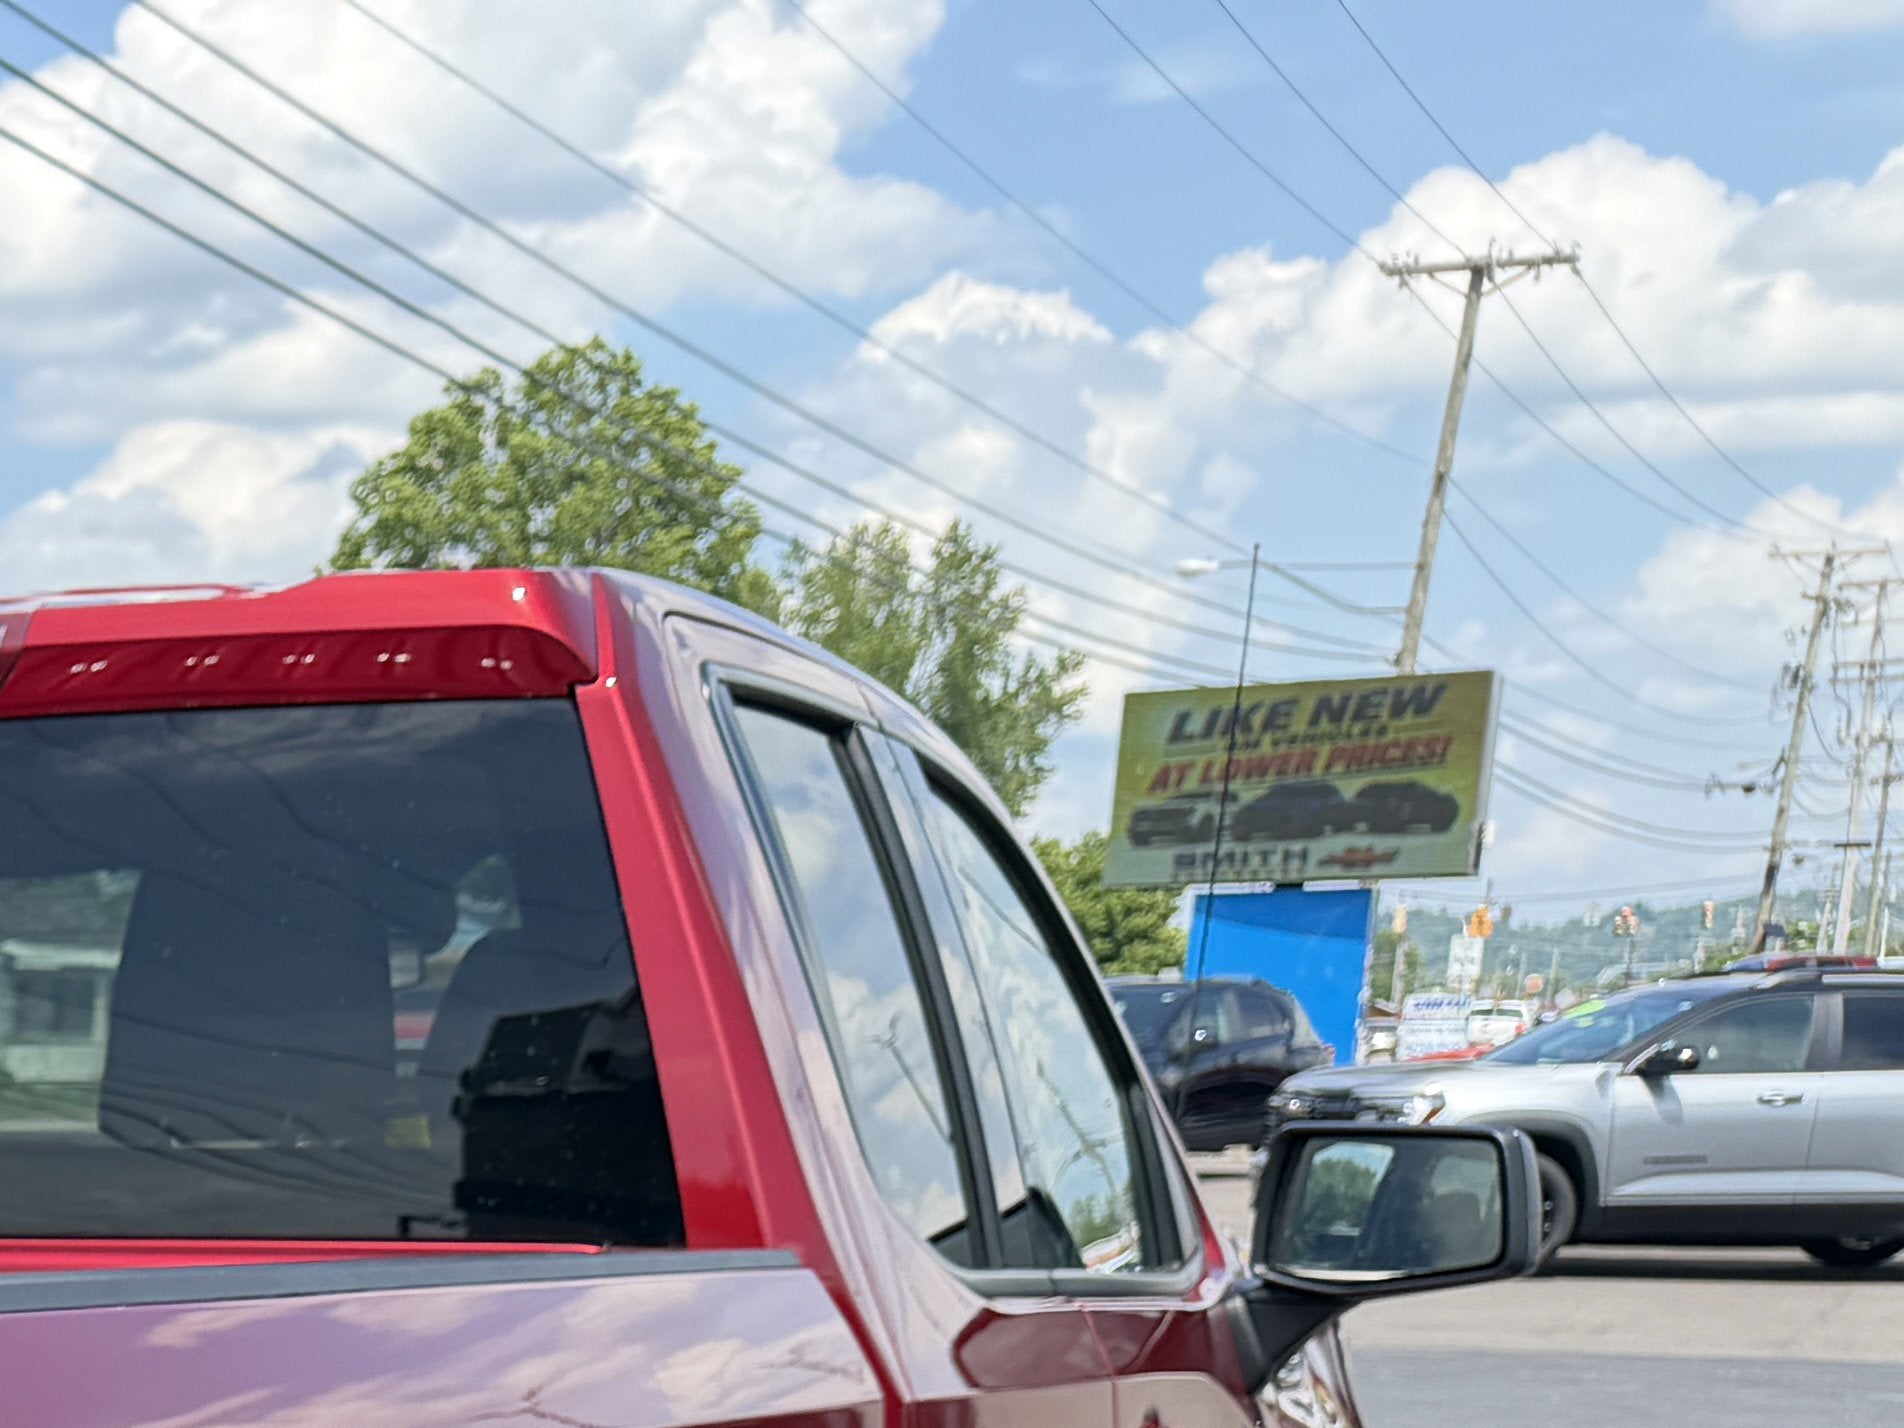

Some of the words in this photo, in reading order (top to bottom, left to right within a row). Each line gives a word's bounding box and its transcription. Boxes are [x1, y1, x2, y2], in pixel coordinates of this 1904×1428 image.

[1165, 699, 1300, 745] LIKE
[1308, 681, 1450, 727] NEW
[1146, 760, 1194, 795] AT
[1199, 748, 1320, 784] LOWER
